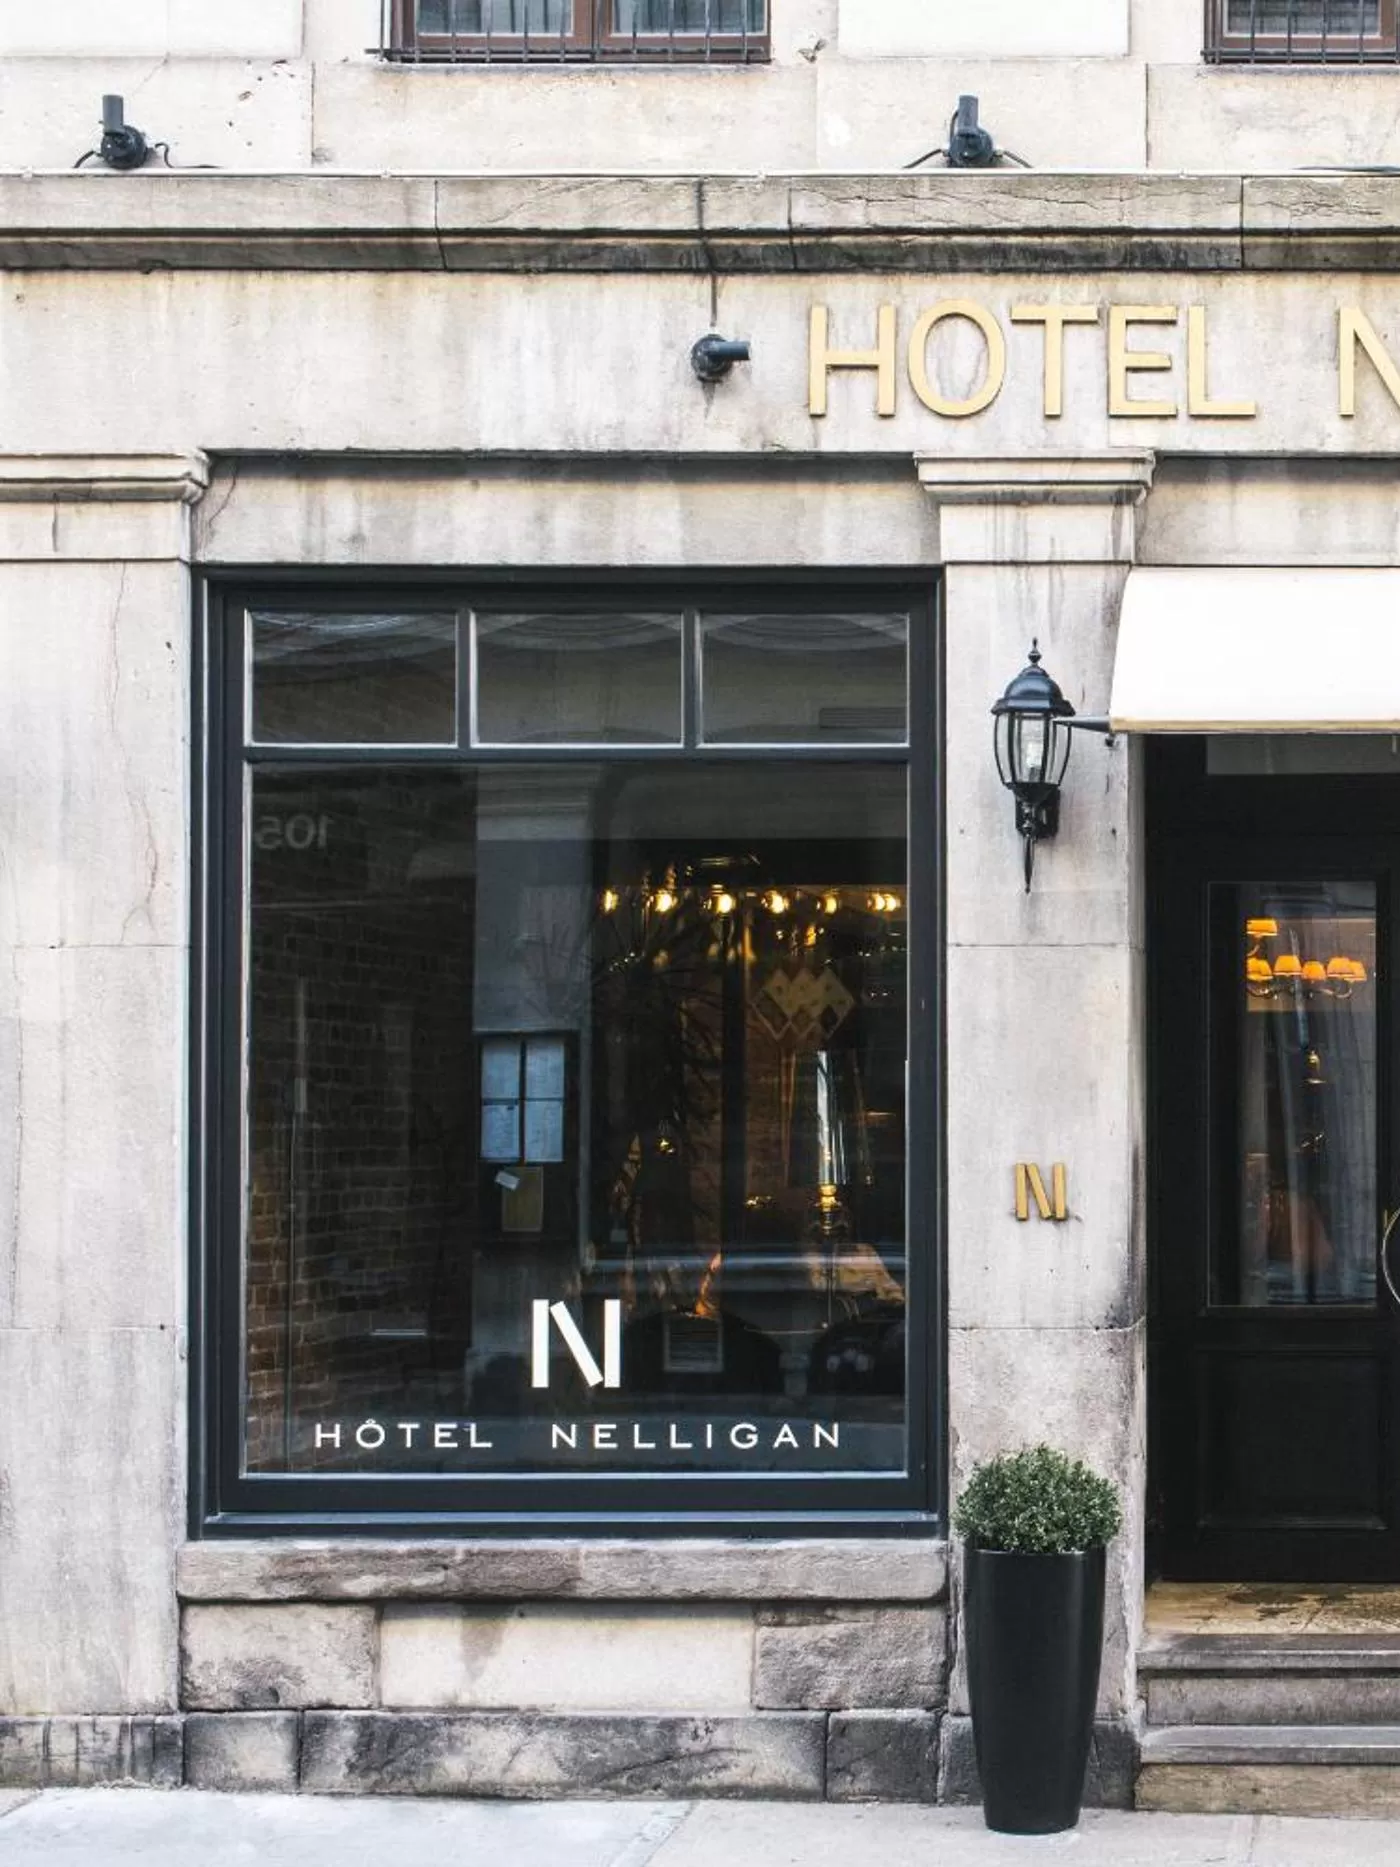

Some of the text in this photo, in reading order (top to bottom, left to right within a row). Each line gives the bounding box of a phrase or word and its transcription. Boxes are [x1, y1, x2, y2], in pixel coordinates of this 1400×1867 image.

[808, 299, 1257, 417] HOTEL
[1014, 1161, 1067, 1221] N
[531, 1298, 621, 1388] N
[314, 1418, 840, 1449] HÔTEL NELLIGAN
